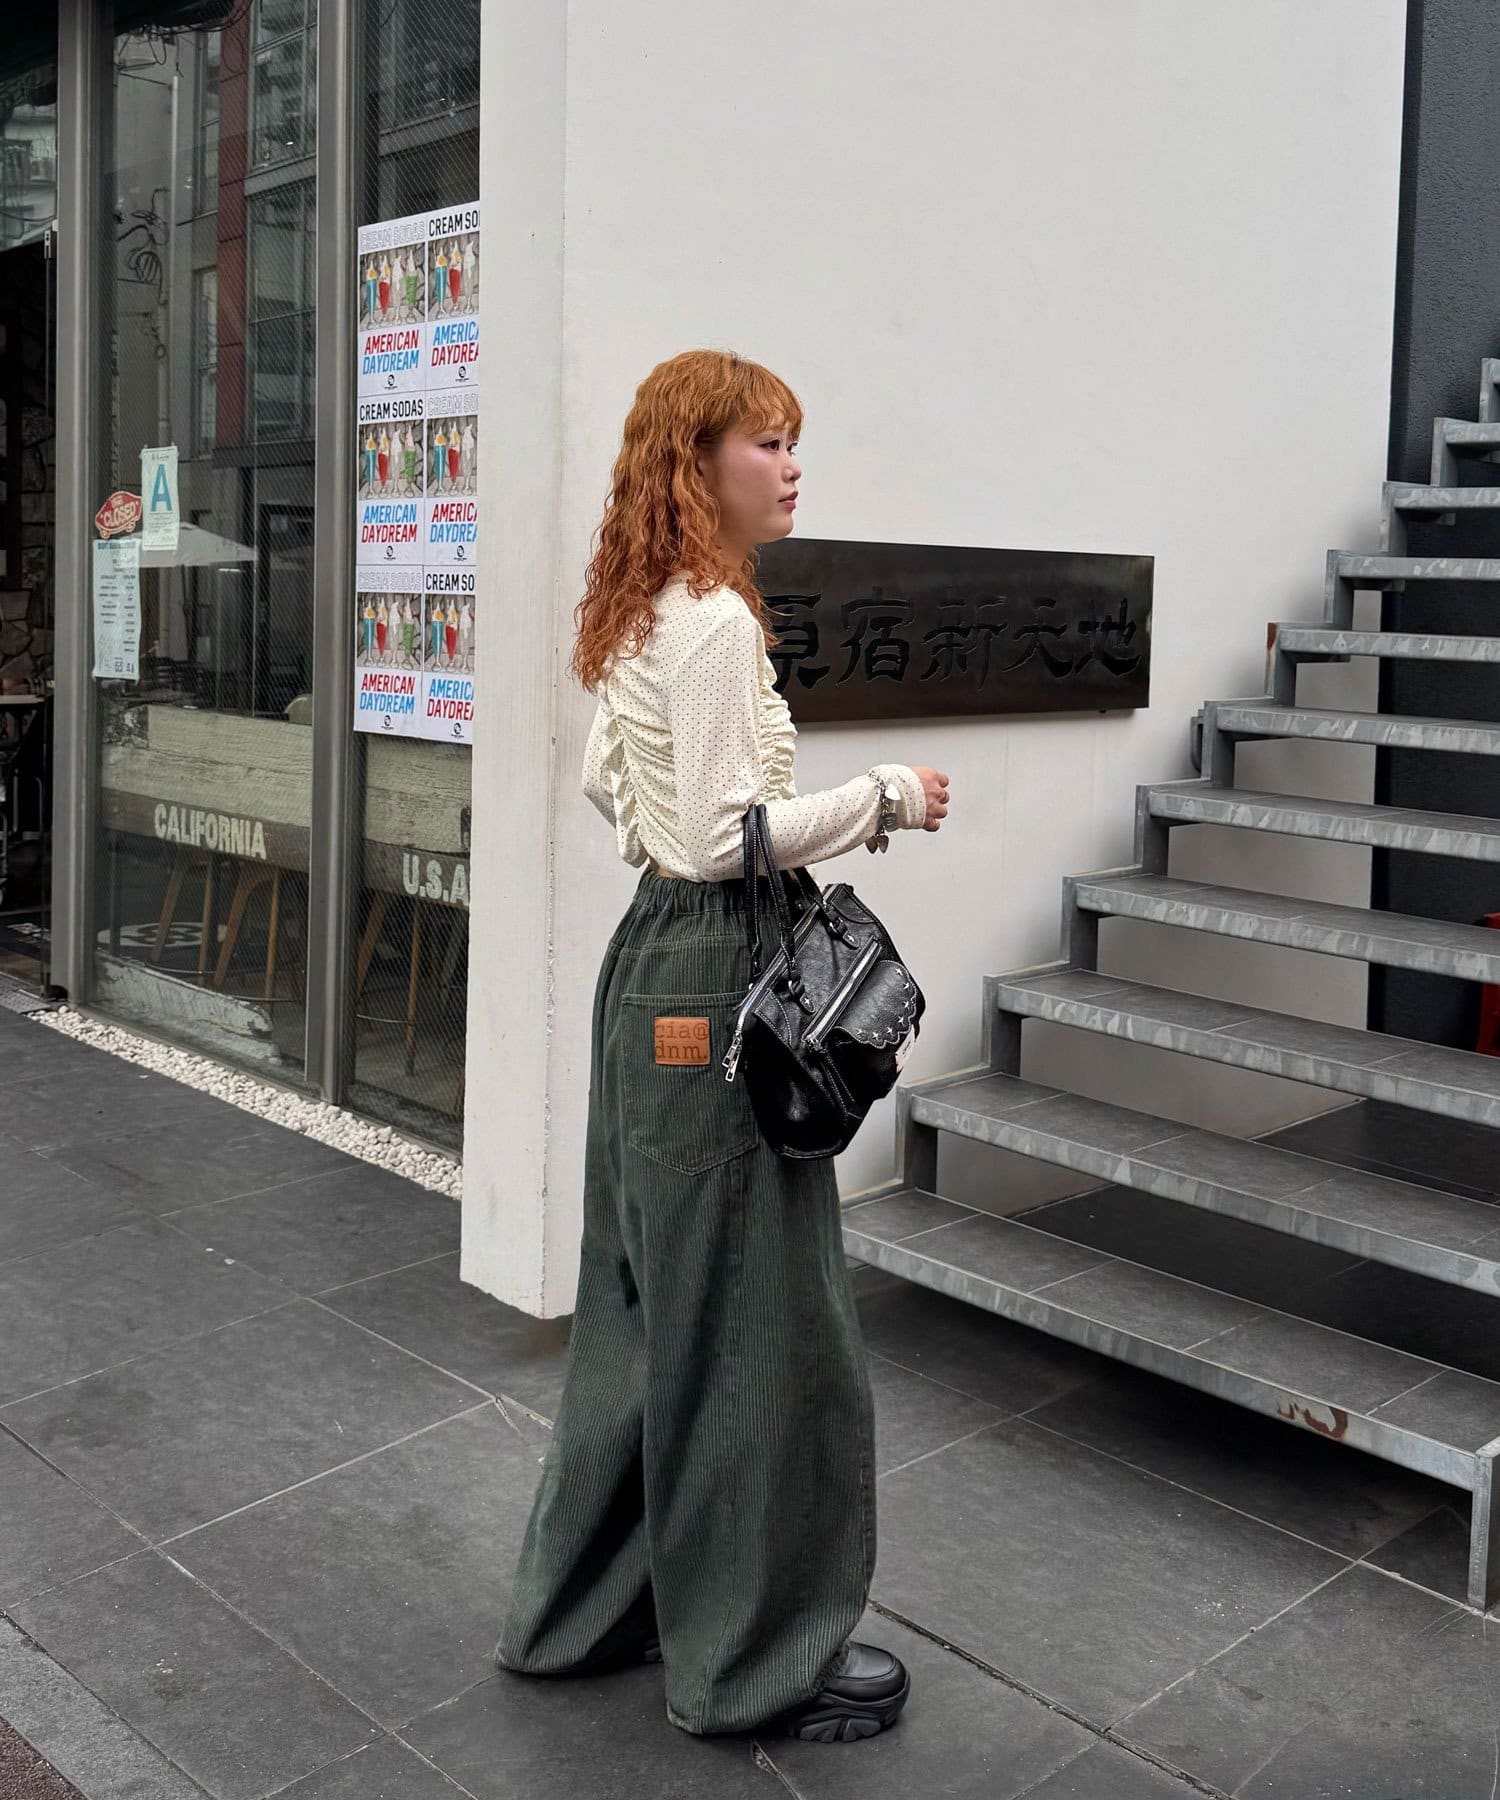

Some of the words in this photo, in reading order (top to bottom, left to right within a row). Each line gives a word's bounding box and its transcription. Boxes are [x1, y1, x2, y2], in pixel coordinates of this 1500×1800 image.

[428, 213, 463, 237] CREAM
[364, 329, 419, 355] AMERICAN
[362, 350, 419, 375] DAYDREAM
[360, 402, 390, 421] CREAM
[392, 399, 423, 418] SODAS
[150, 463, 172, 513] A
[363, 504, 417, 523] AMERICAN
[361, 524, 418, 543] DAYDREAM
[425, 573, 460, 591] CREAM
[361, 673, 416, 695] AMERICAN
[360, 692, 415, 714] DAYDREAM
[154, 803, 267, 860] CALIFORNIA
